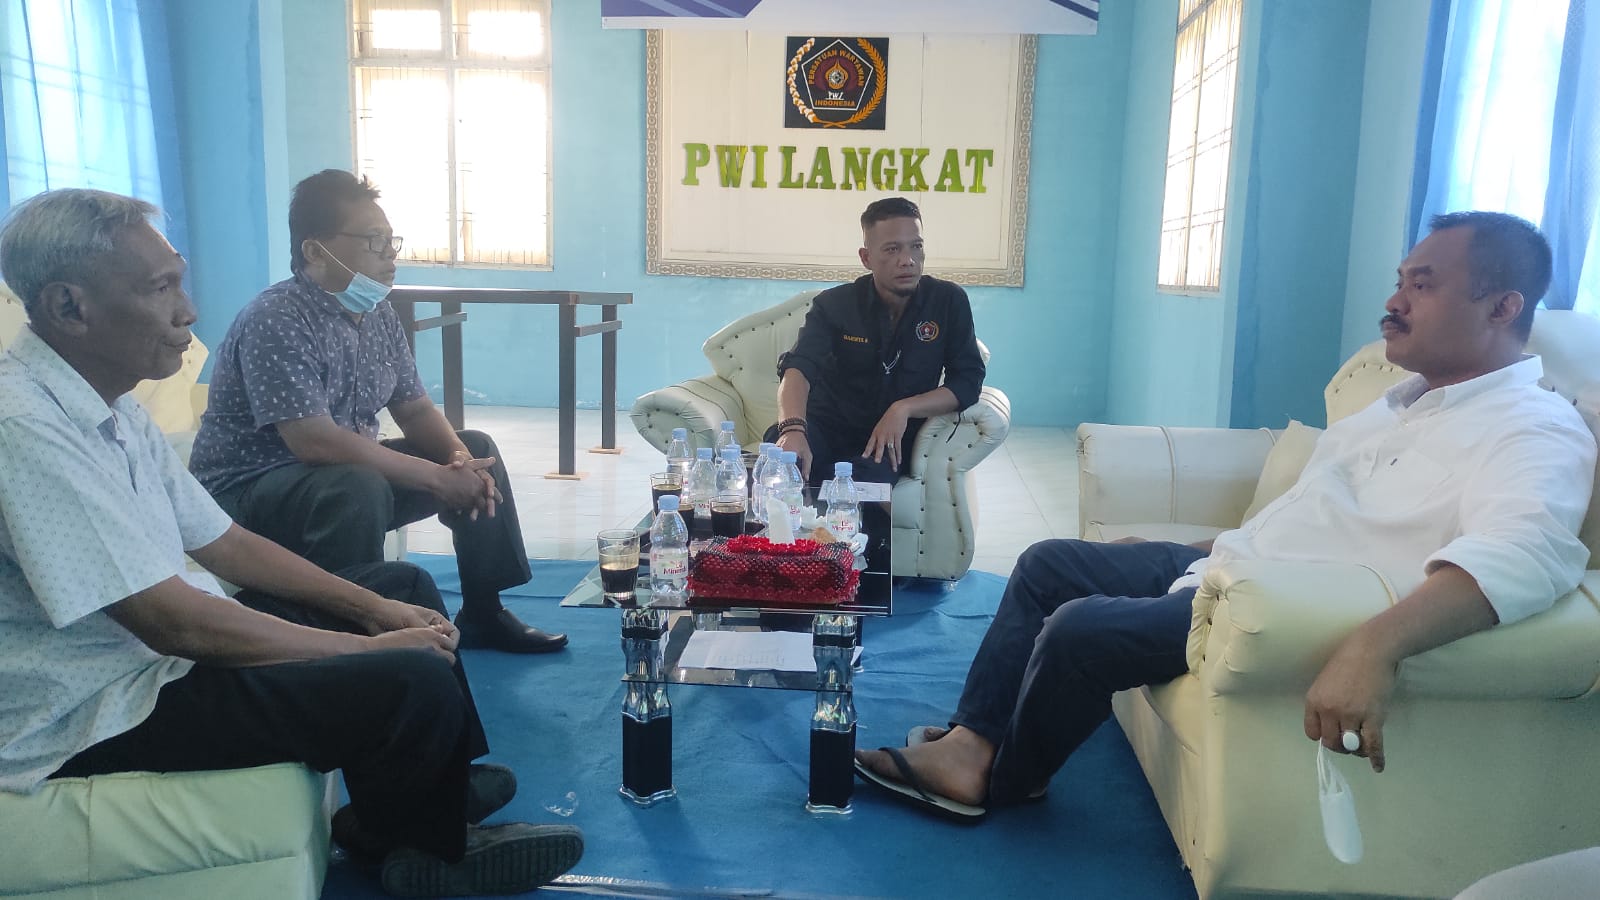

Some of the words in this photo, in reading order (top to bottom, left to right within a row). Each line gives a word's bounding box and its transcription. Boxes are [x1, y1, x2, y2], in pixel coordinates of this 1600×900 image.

[808, 49, 837, 85] PERSATUAN
[839, 50, 865, 87] WARTAWAN
[682, 142, 768, 188] PWI
[778, 145, 994, 193] LANGKAT
